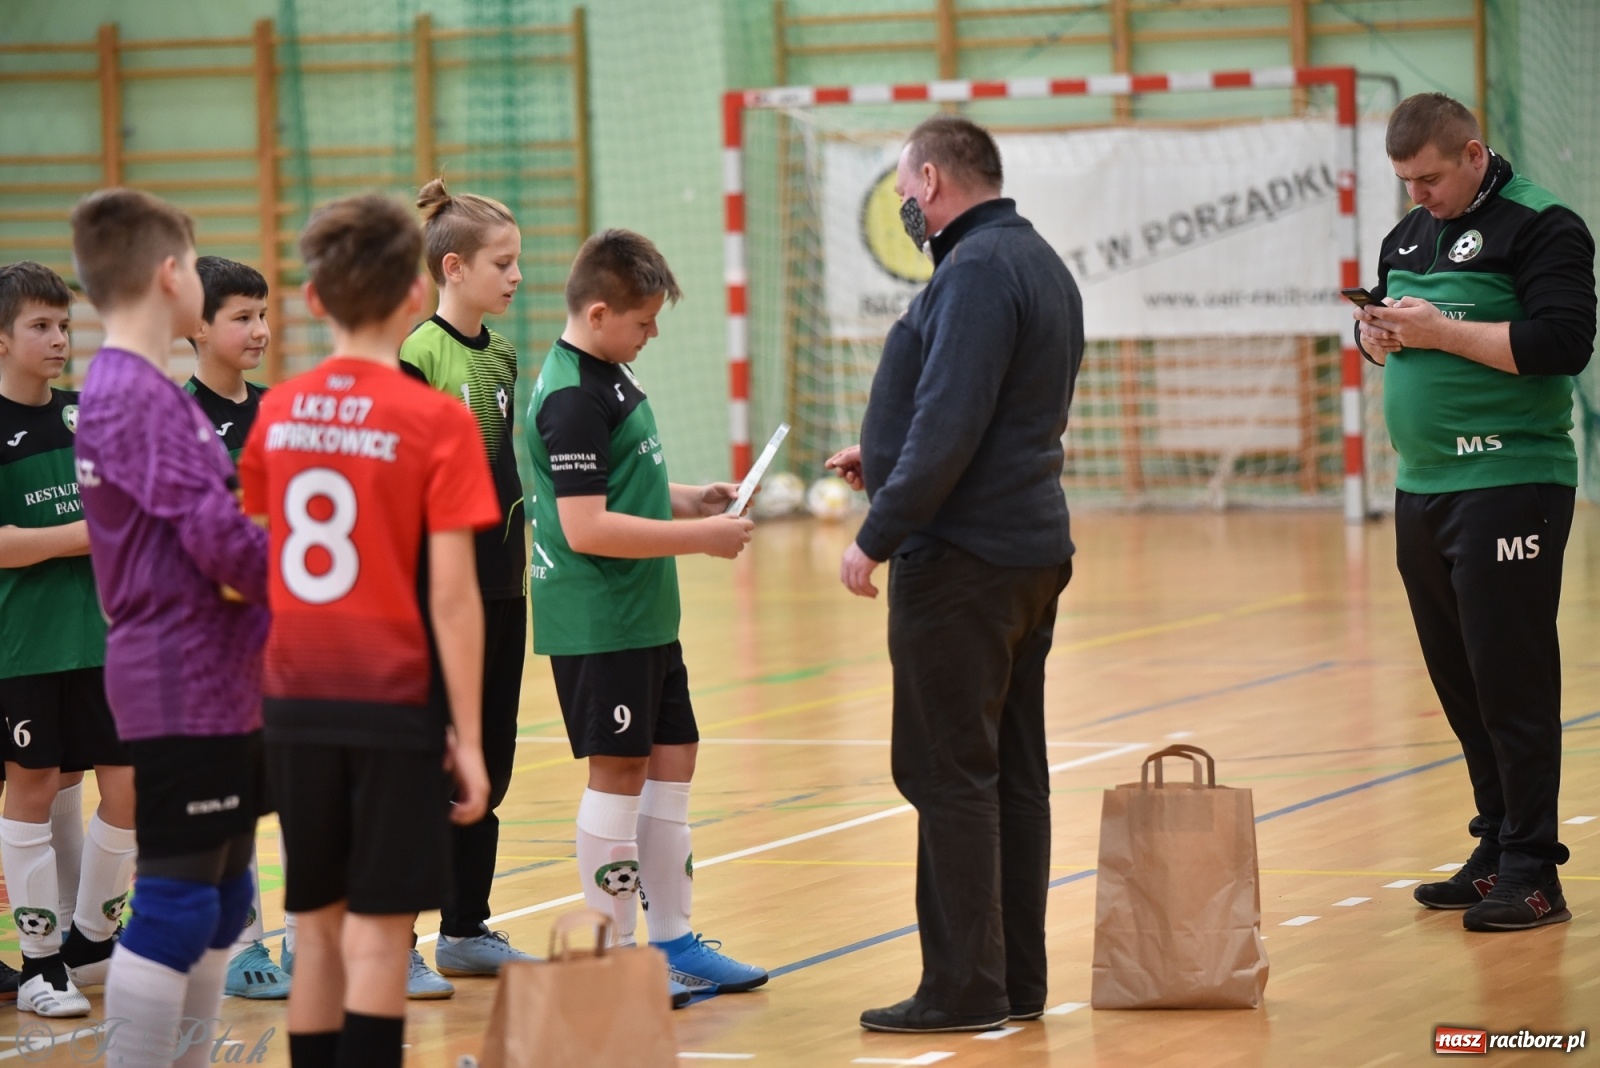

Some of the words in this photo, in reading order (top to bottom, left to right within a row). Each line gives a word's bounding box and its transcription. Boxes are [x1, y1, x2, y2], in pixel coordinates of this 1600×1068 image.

[1097, 233, 1131, 270] W
[292, 393, 338, 423] LKS
[338, 394, 374, 425] 07
[266, 421, 401, 462] MARKOWICE
[1456, 434, 1503, 456] MS
[280, 466, 361, 606] 8
[1496, 534, 1540, 562] MS
[613, 704, 632, 734] 9
